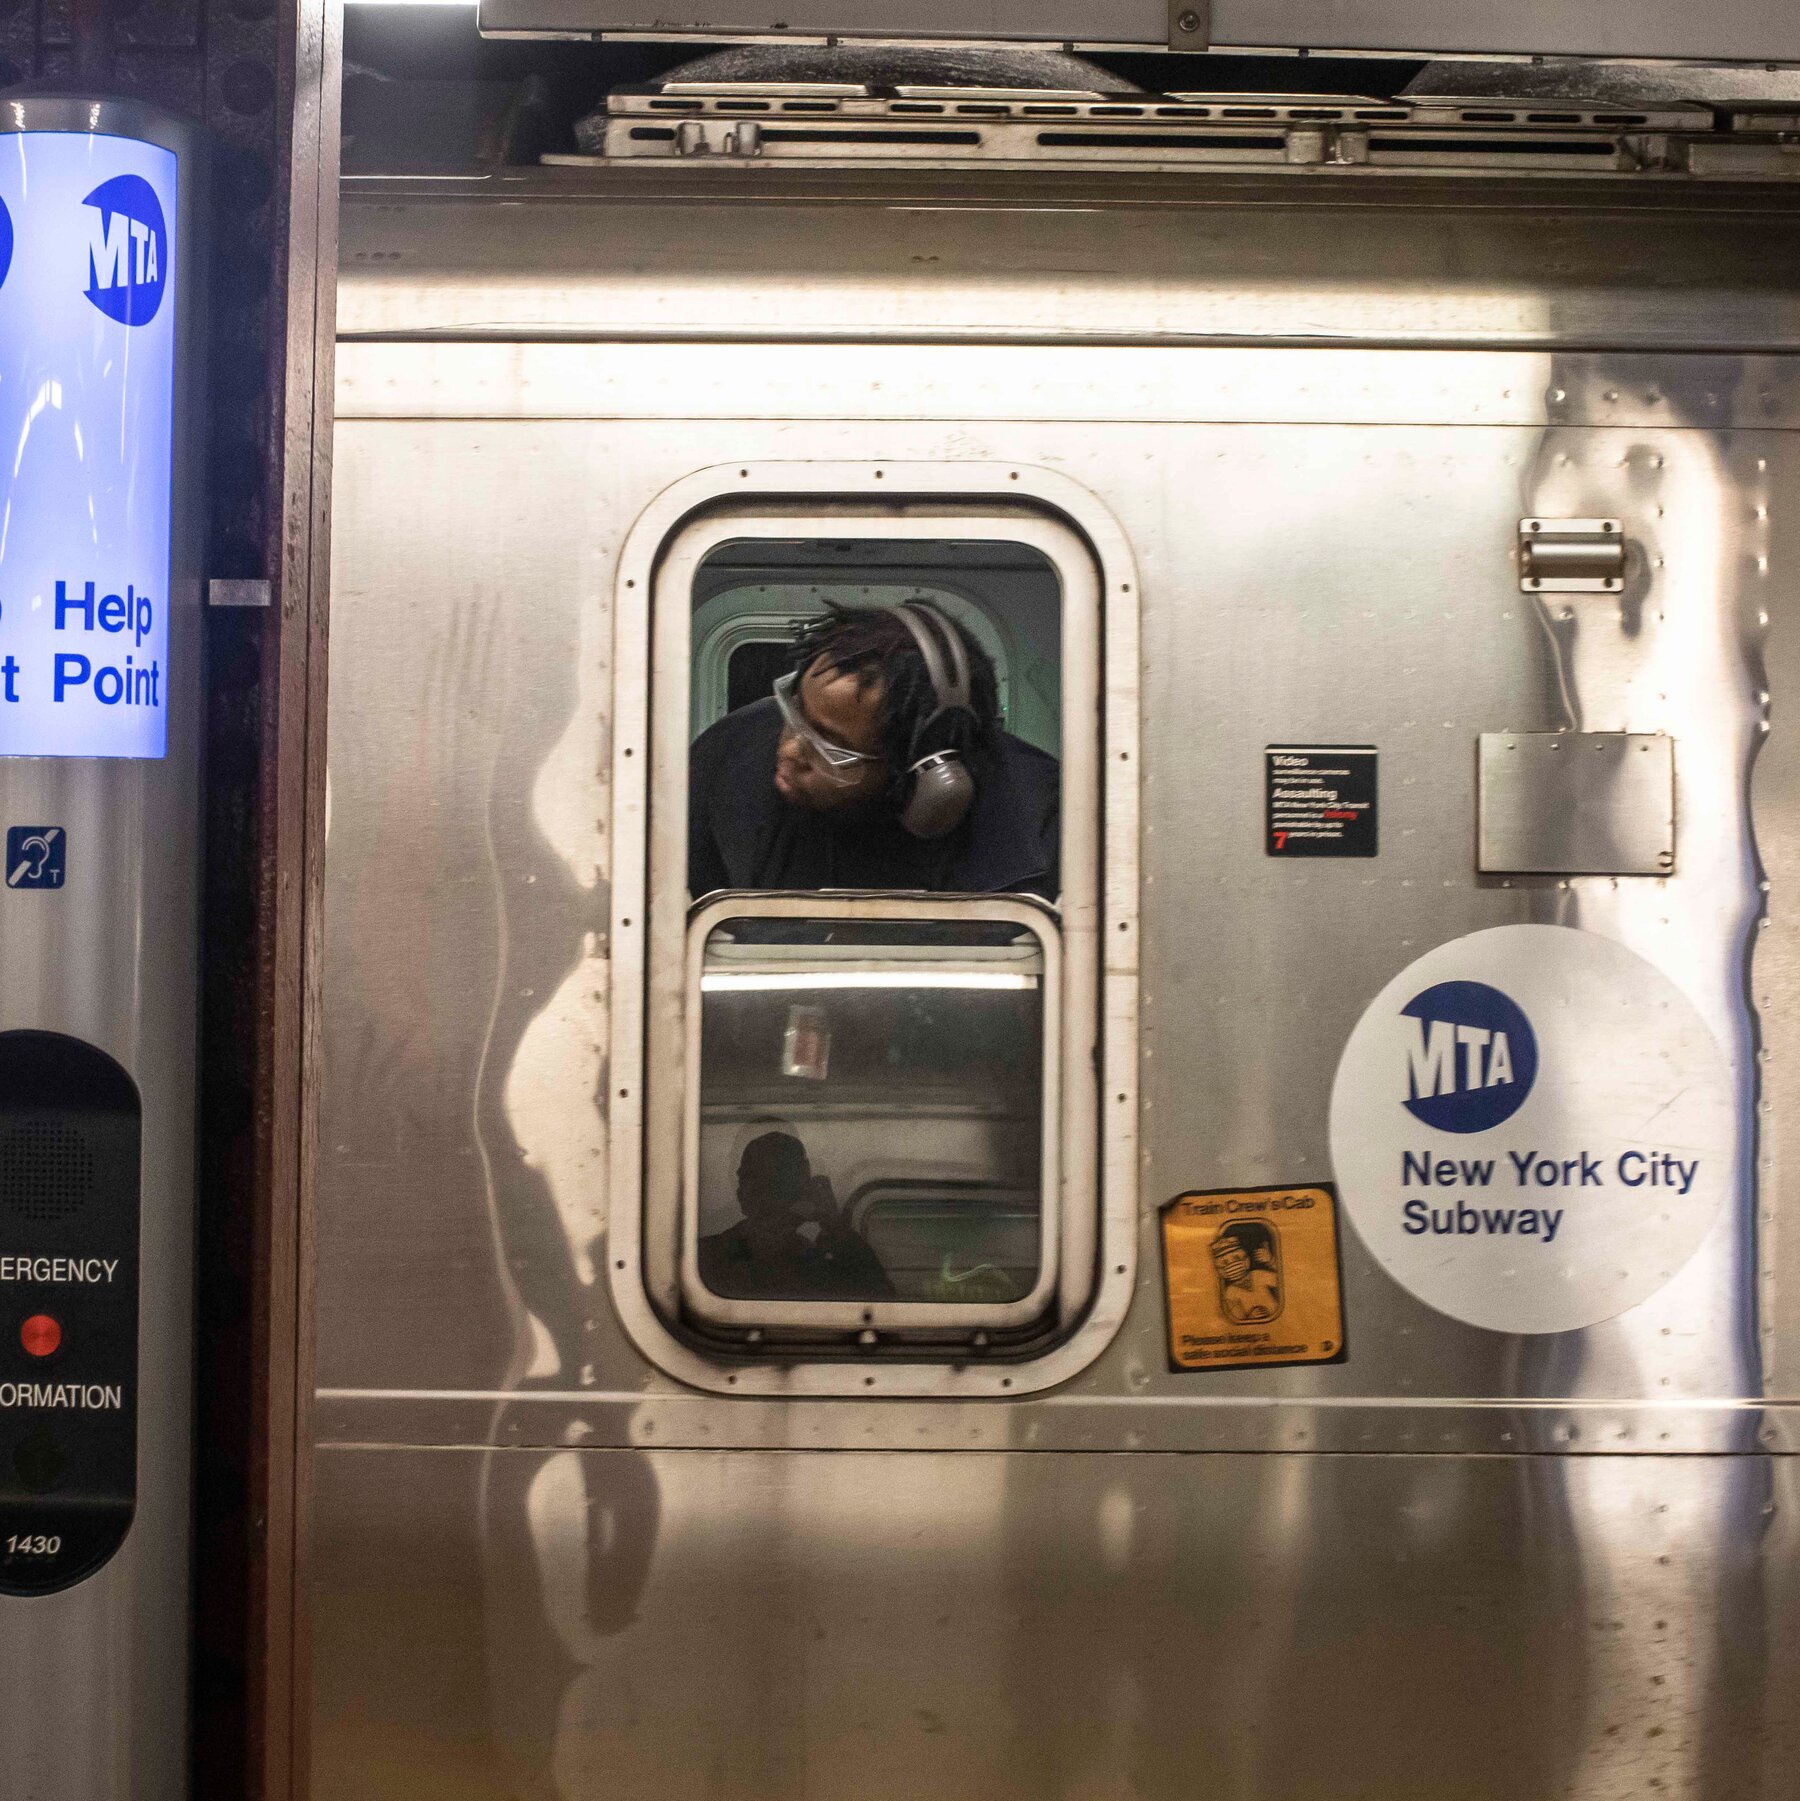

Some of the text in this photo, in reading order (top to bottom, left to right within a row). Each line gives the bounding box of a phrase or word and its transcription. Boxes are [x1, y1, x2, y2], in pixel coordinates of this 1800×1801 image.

[82, 203, 158, 291] MTA
[54, 580, 153, 647] Help
[53, 653, 159, 708] Point
[1272, 755, 1309, 767] Video
[1272, 787, 1338, 801] Assaulting
[1272, 831, 1289, 849] 7
[1400, 1014, 1514, 1101] MTA
[1402, 1150, 1700, 1195] New York City
[1181, 1195, 1316, 1216] Train Crew's Cab
[1402, 1199, 1564, 1243] Subway
[7, 1534, 61, 1554] 1430
